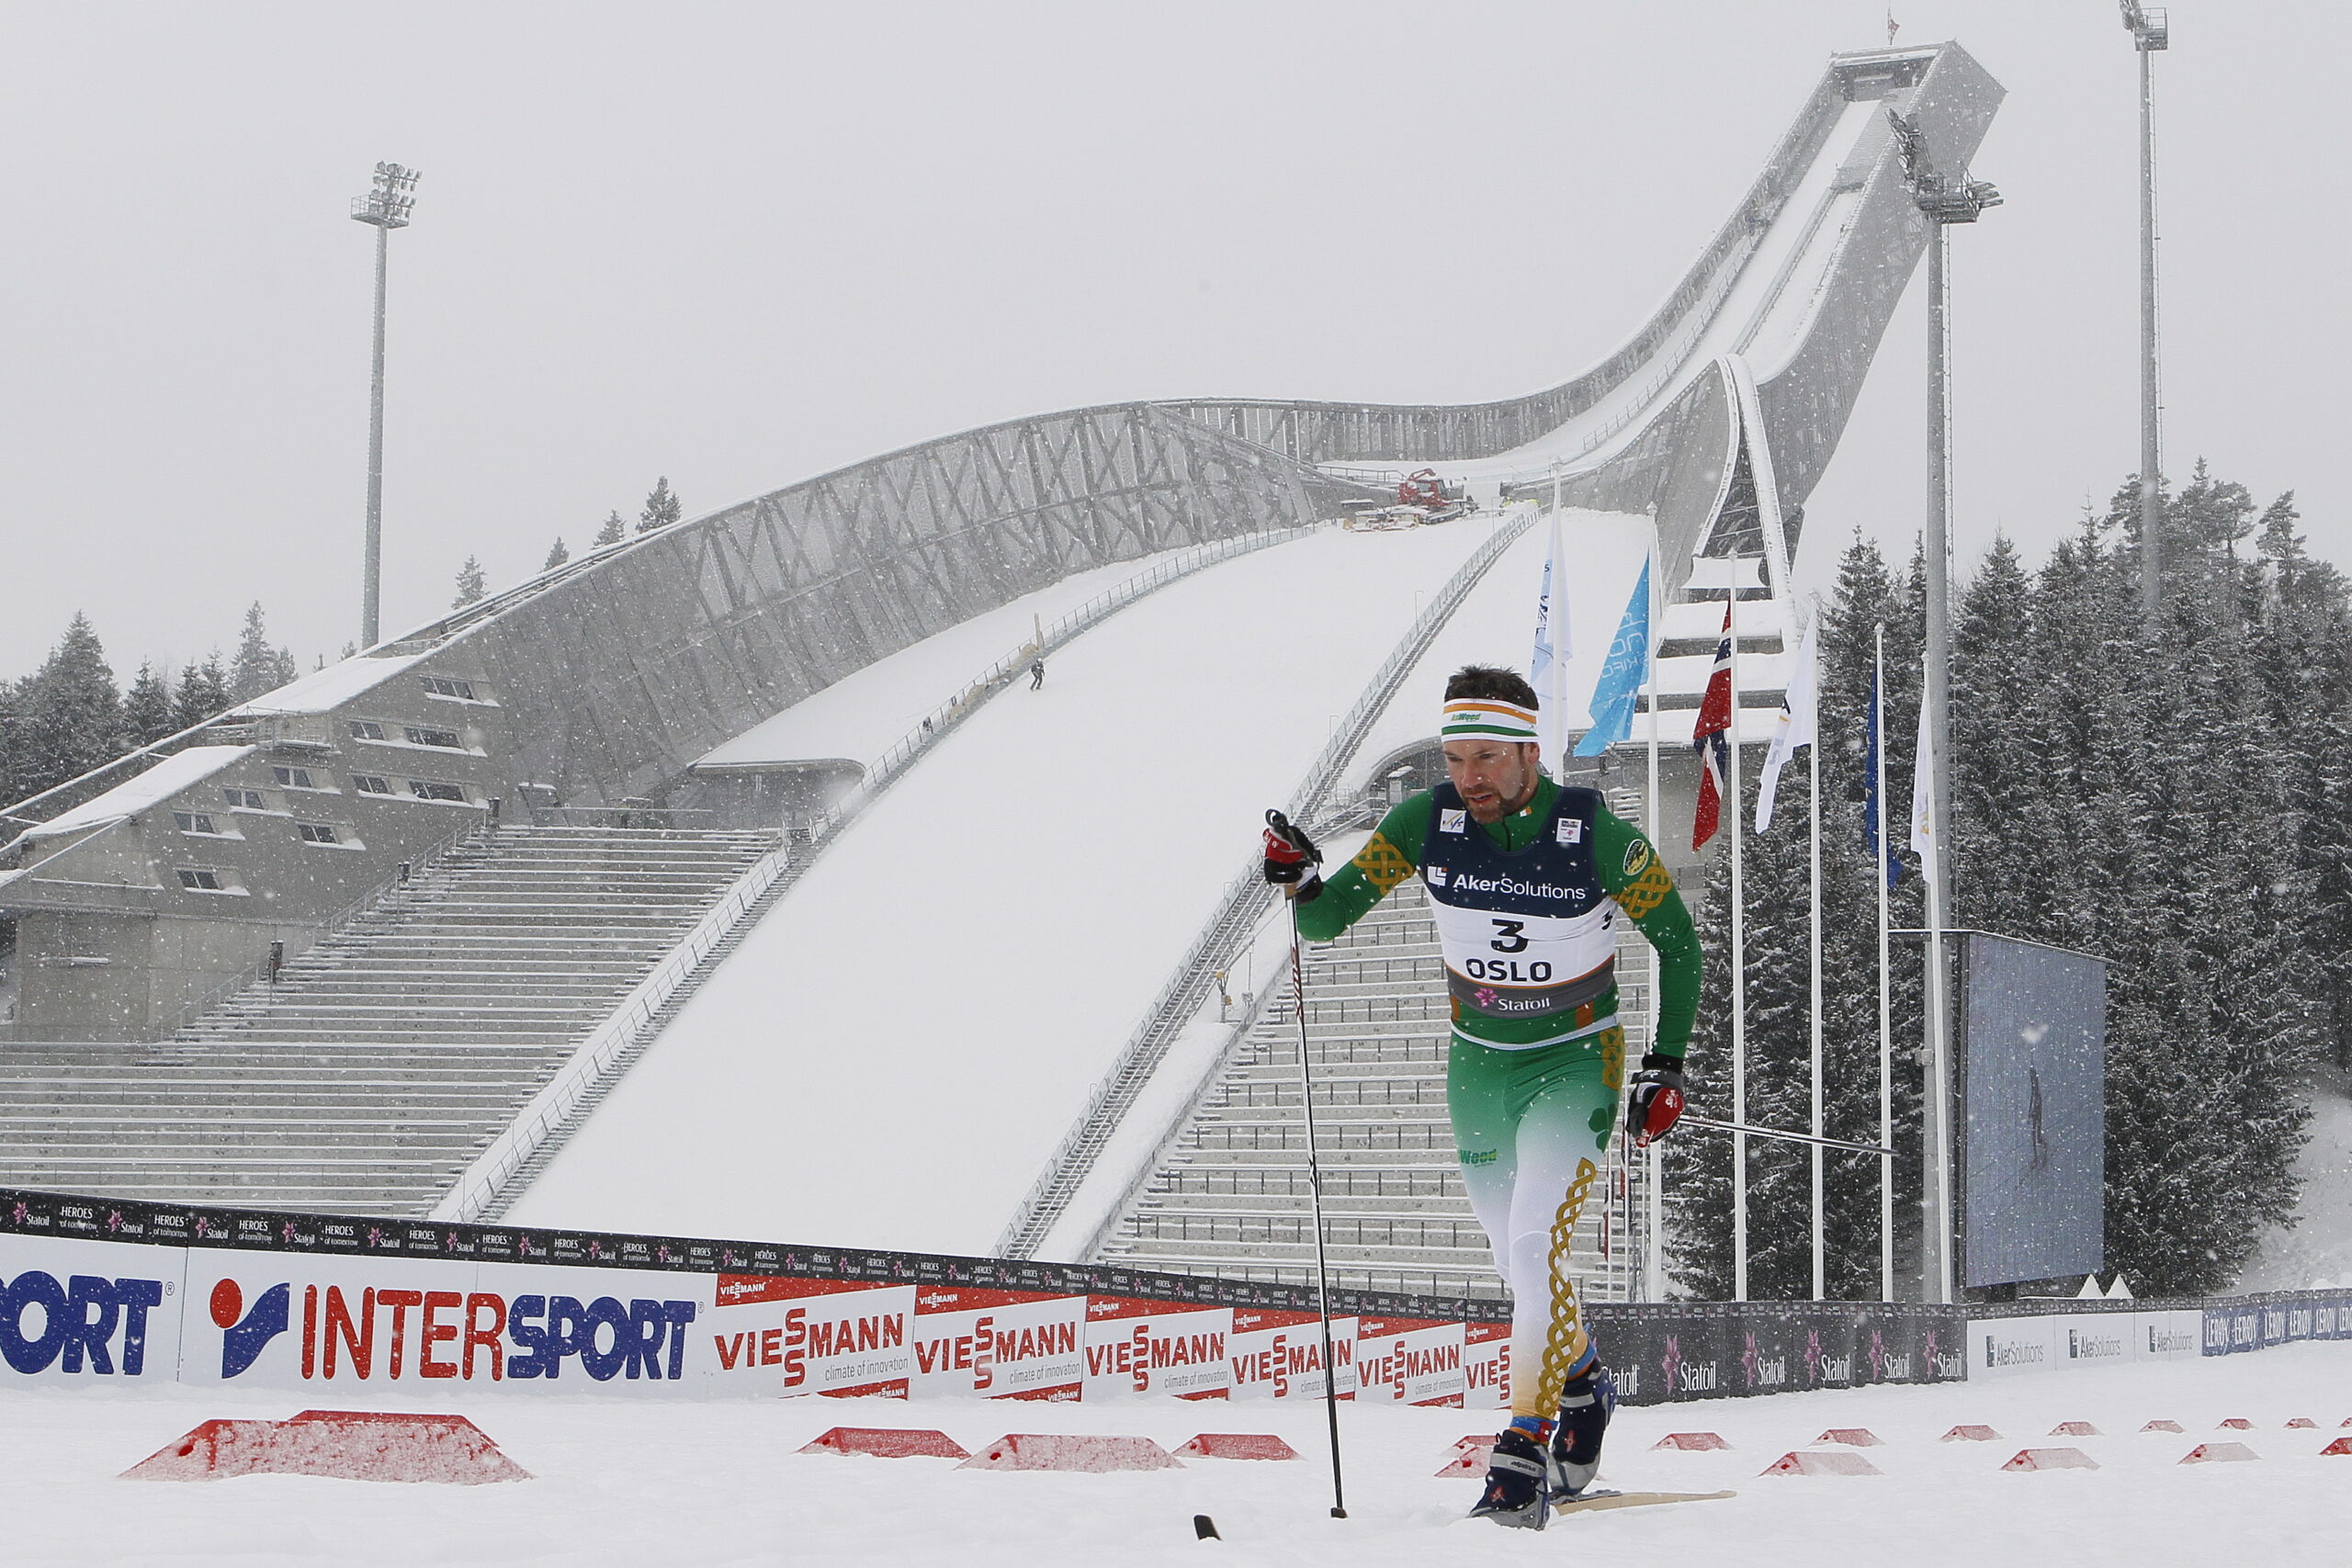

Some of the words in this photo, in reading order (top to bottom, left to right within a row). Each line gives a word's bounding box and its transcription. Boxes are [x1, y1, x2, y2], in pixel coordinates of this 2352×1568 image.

[1453, 874, 1586, 900] AkerSolutions
[1490, 919, 1529, 953] 3
[1465, 958, 1553, 983] OSLO
[1498, 998, 1551, 1011] Statoil
[27, 1214, 50, 1226] Statoil
[62, 1206, 93, 1219] HEROES
[154, 1214, 185, 1226] HEROES
[120, 1223, 142, 1234] Statoil
[207, 1228, 228, 1238] Statoil
[239, 1220, 268, 1231] HEROES
[325, 1224, 354, 1236] HEROES
[409, 1230, 435, 1240] HEROES
[238, 1232, 244, 1240] of
[294, 1233, 315, 1244] Statoil
[331, 1238, 358, 1247] tomorrow
[379, 1238, 400, 1248] Statoil
[482, 1235, 507, 1245] HEROES
[554, 1239, 578, 1249] HEROES
[457, 1242, 474, 1252] Statoil
[690, 1247, 711, 1257] HEROES
[719, 1281, 765, 1299] VIESSMANN
[920, 1292, 958, 1308] VIESSMANN
[0, 1270, 163, 1376] ORT
[301, 1283, 696, 1382] INTERSPORT
[714, 1308, 904, 1388] VIESSMANN
[2080, 1336, 2120, 1358] AkerSolutions
[2157, 1331, 2192, 1353] AkerSolutions
[914, 1316, 1076, 1390] VIESSMANN
[1086, 1325, 1225, 1393] VIESSMANN
[1996, 1341, 2043, 1367] AkerSolutions
[825, 1364, 854, 1381] climate
[857, 1360, 865, 1376] of
[867, 1357, 909, 1375] innovation
[1010, 1369, 1035, 1383] climate
[1037, 1365, 1045, 1380] of
[1046, 1360, 1080, 1377] innovation
[1358, 1340, 1460, 1400] VIESSMANN
[1758, 1356, 1785, 1385] Statoil
[1821, 1352, 1850, 1382] Statoil
[1883, 1352, 1910, 1378] Statoil
[1938, 1352, 1962, 1378] Statoil
[1164, 1374, 1188, 1388] climate
[1190, 1371, 1196, 1385] of
[1197, 1369, 1228, 1383] innovation
[1602, 1364, 1638, 1396] tatoil
[1680, 1360, 1716, 1392] Statoil
[1510, 1459, 1537, 1472] alpina
